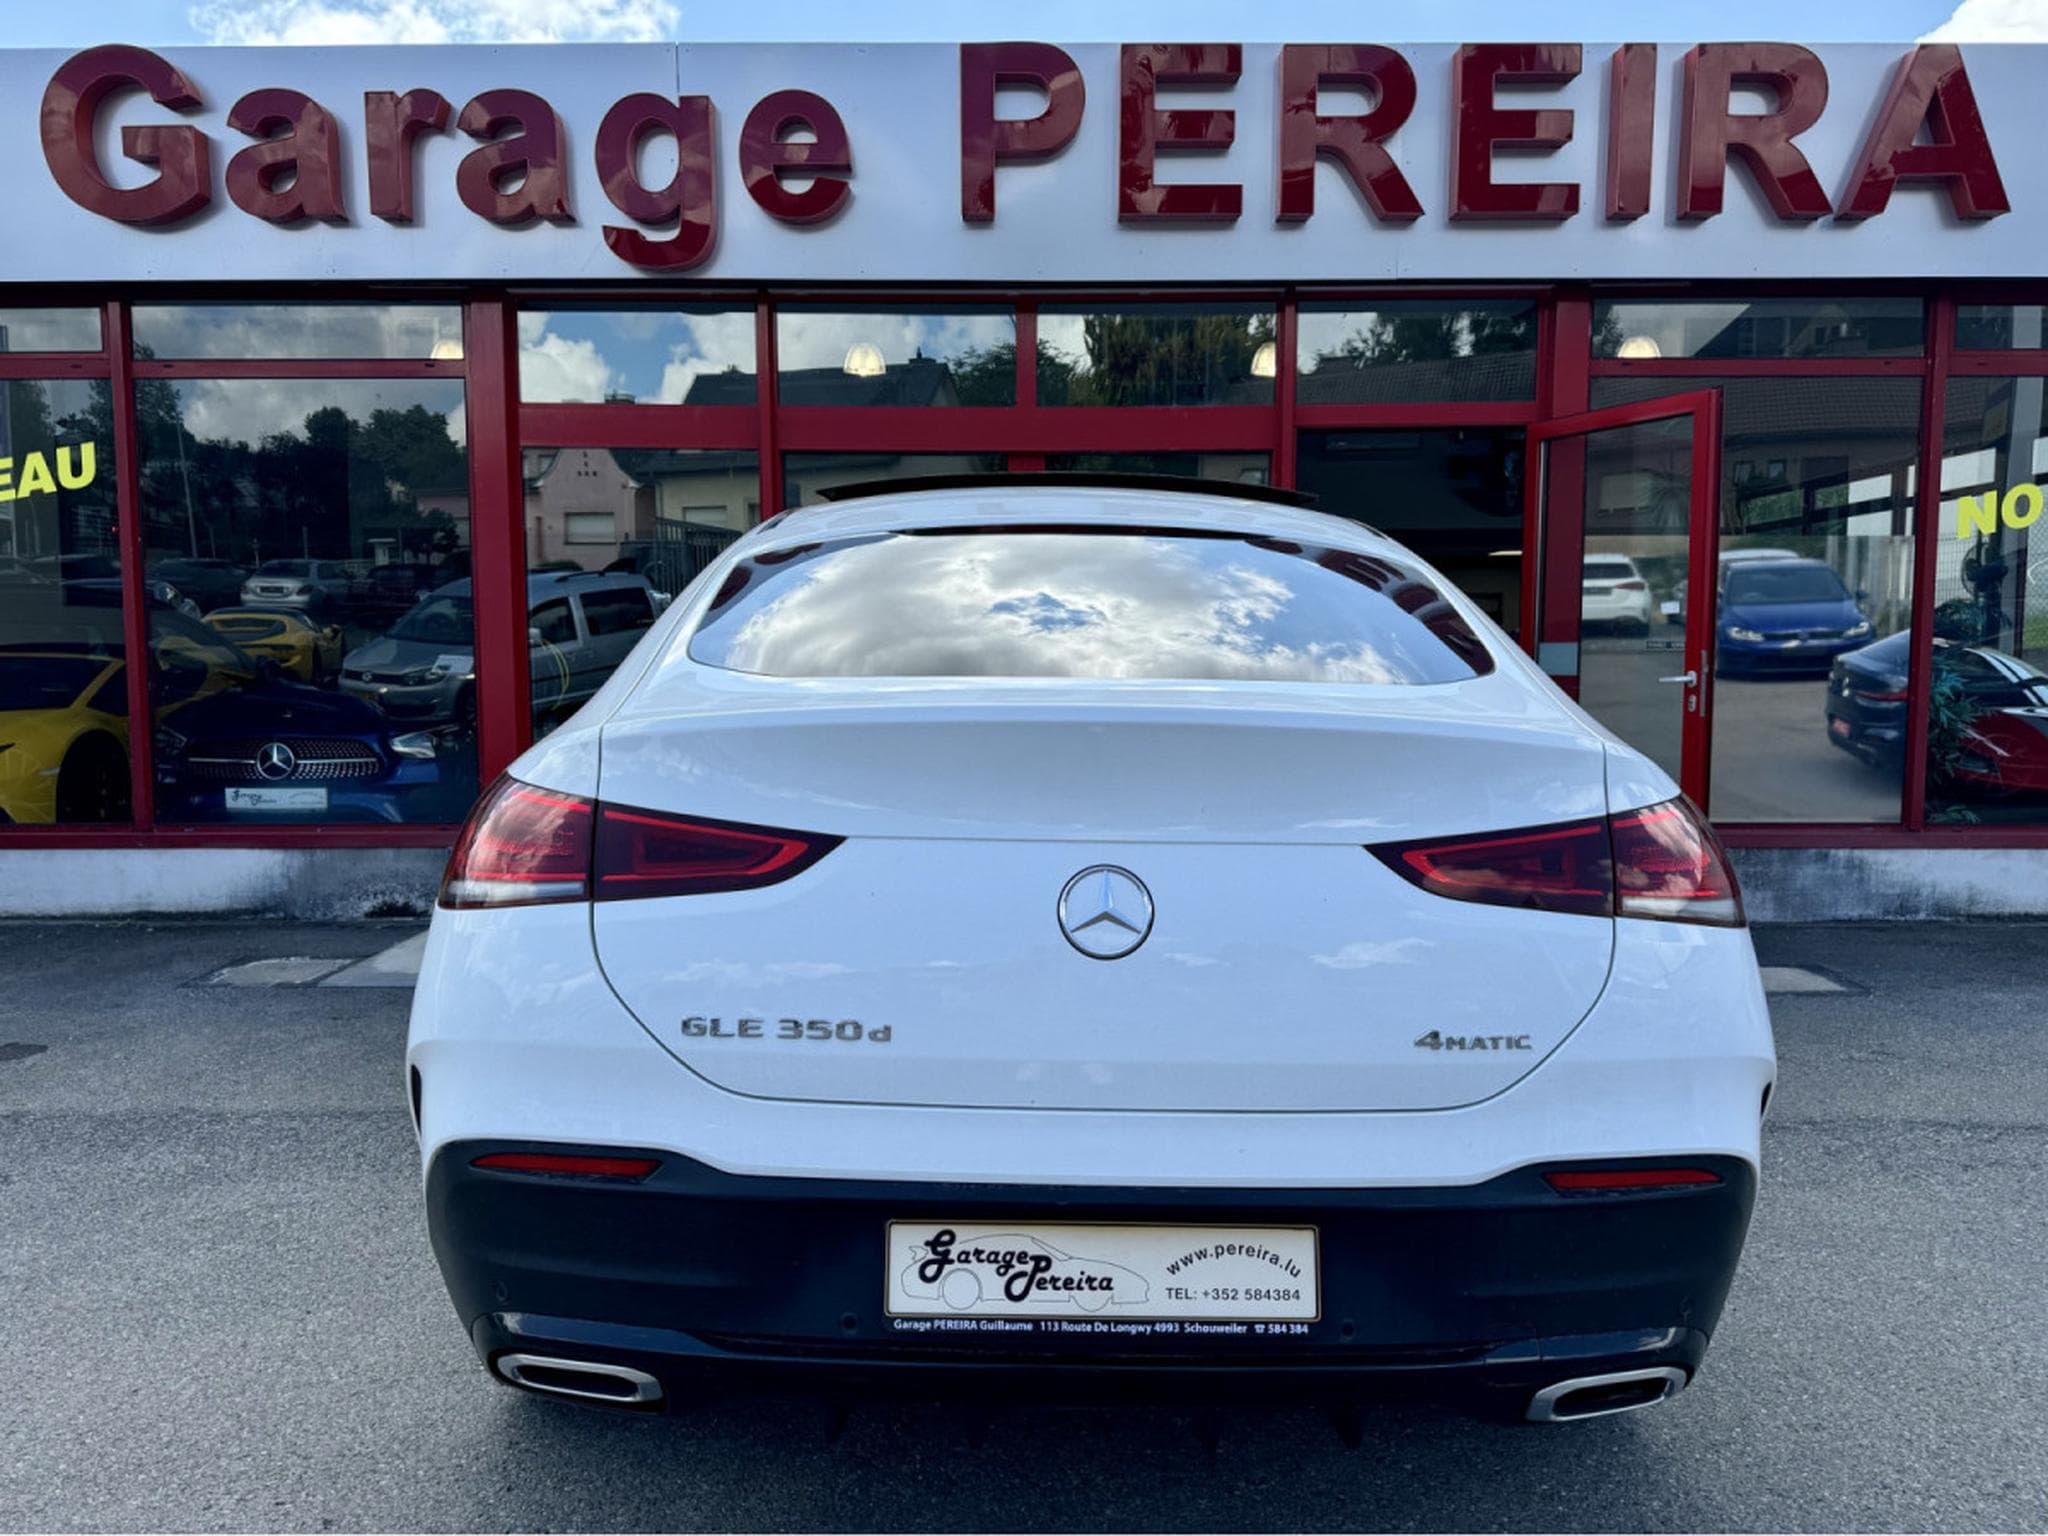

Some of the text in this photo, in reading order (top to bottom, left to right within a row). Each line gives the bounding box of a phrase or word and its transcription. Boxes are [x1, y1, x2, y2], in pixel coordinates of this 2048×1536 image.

[40, 43, 2010, 272] Garage PEREIRA
[1957, 483, 2044, 539] NO
[681, 1016, 764, 1038] GLE
[1414, 1030, 1532, 1050] 4MATIC
[919, 1229, 1031, 1284] Garage
[1166, 1243, 1302, 1278] www.pereira.lu
[1004, 1254, 1115, 1303] Pereira
[1166, 1287, 1301, 1301] TEL: +352 584384
[893, 1318, 1309, 1335] Garage PEREIRA Guillaume 113 Route De Longwy 4993 Schouweiler 584 384
